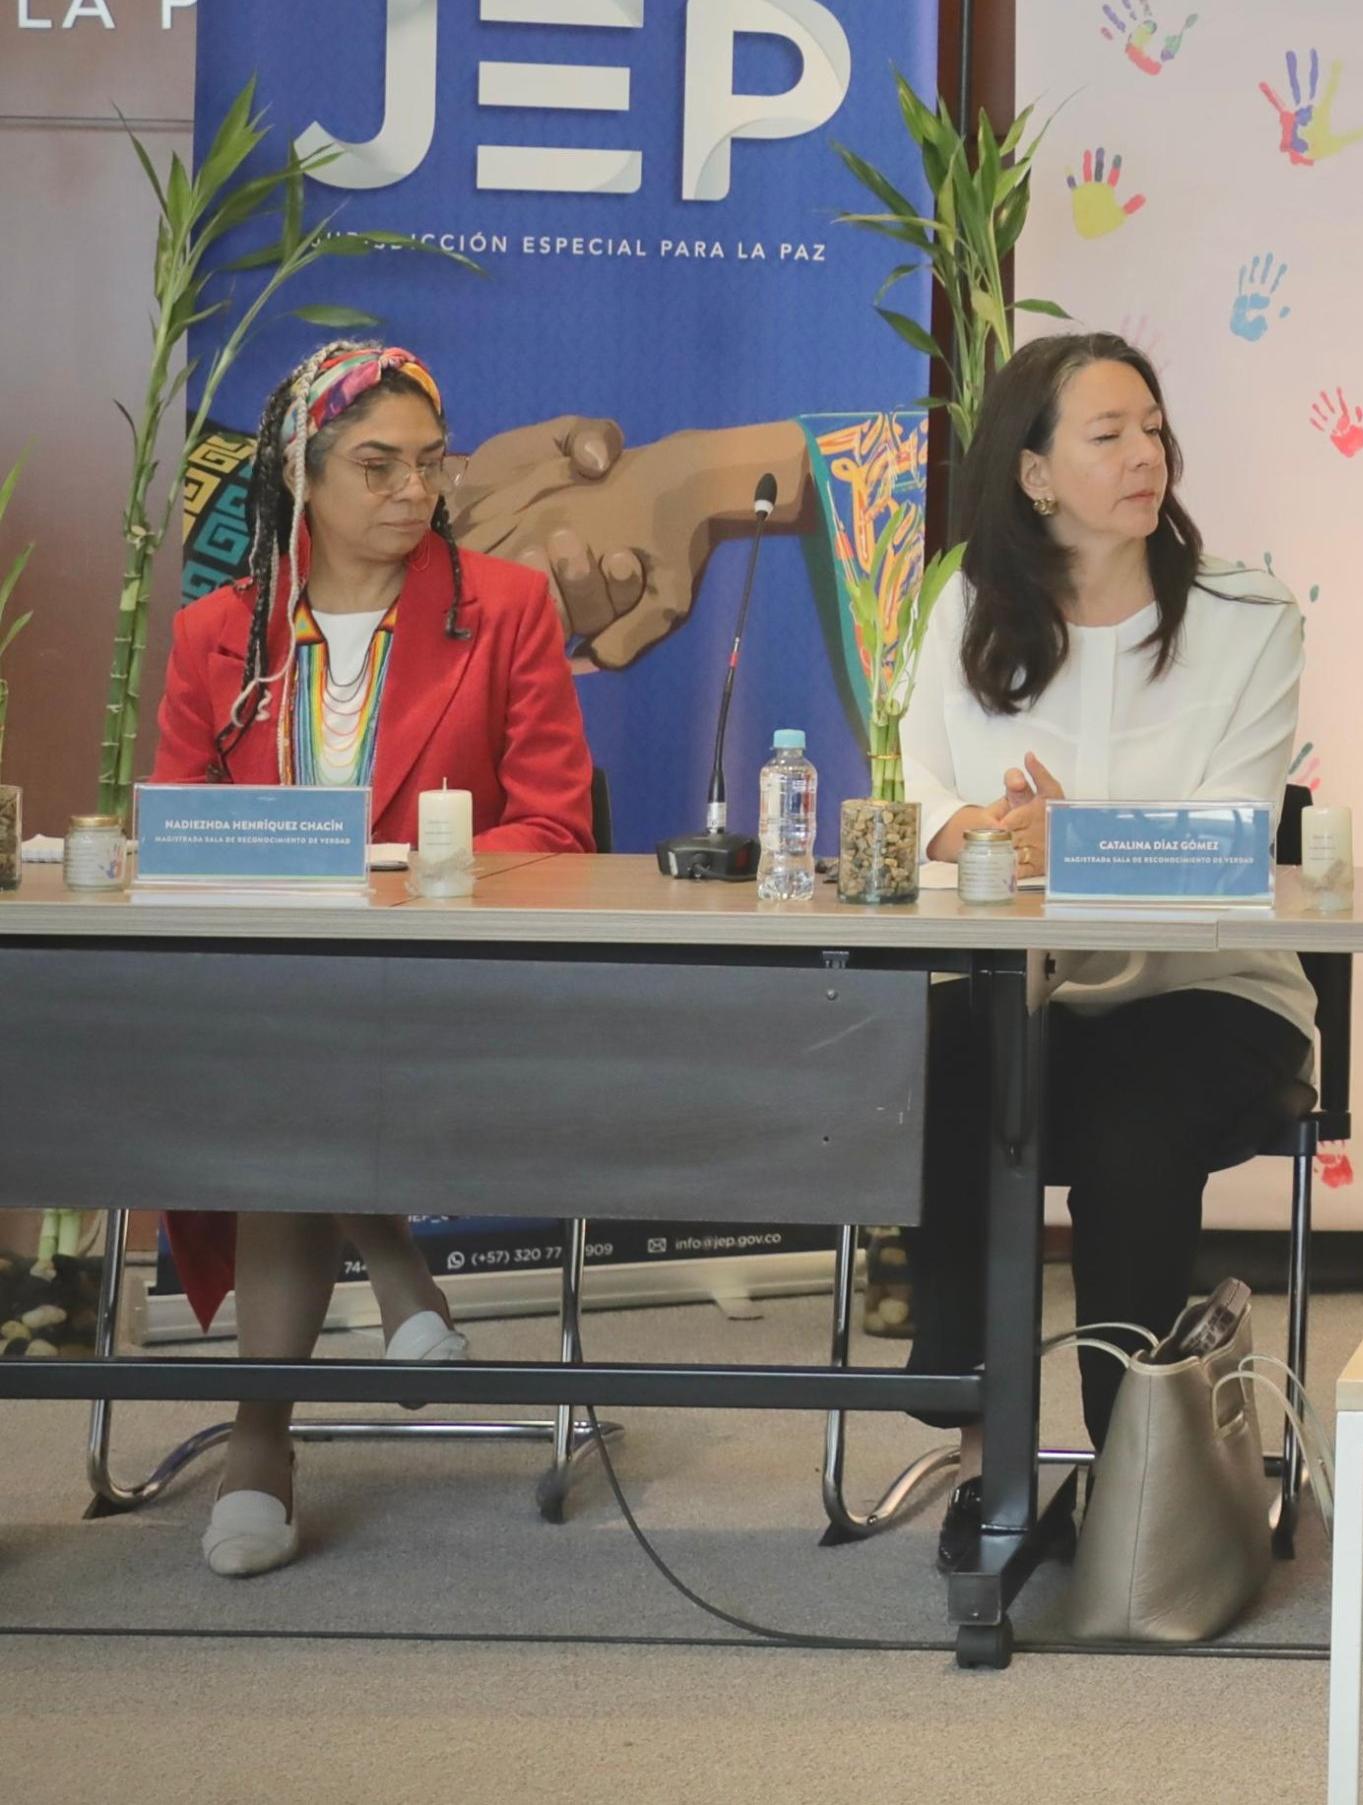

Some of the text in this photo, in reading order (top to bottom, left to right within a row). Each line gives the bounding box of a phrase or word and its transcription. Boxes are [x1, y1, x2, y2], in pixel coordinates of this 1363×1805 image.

[294, 0, 852, 201] JEP
[522, 236, 647, 257] ESPECIAL
[660, 240, 725, 259] PARA
[738, 242, 766, 260] LA
[780, 243, 826, 262] PAZ
[165, 818, 343, 832] NADIEZHDA HENRÍQUEZ CHACÍN
[1099, 838, 1218, 850] CATALINA DÍAZ GÓMEZ
[675, 1233, 782, 1250] info@jep.gov.co
[471, 1243, 614, 1266] (+57) 320 77 909
